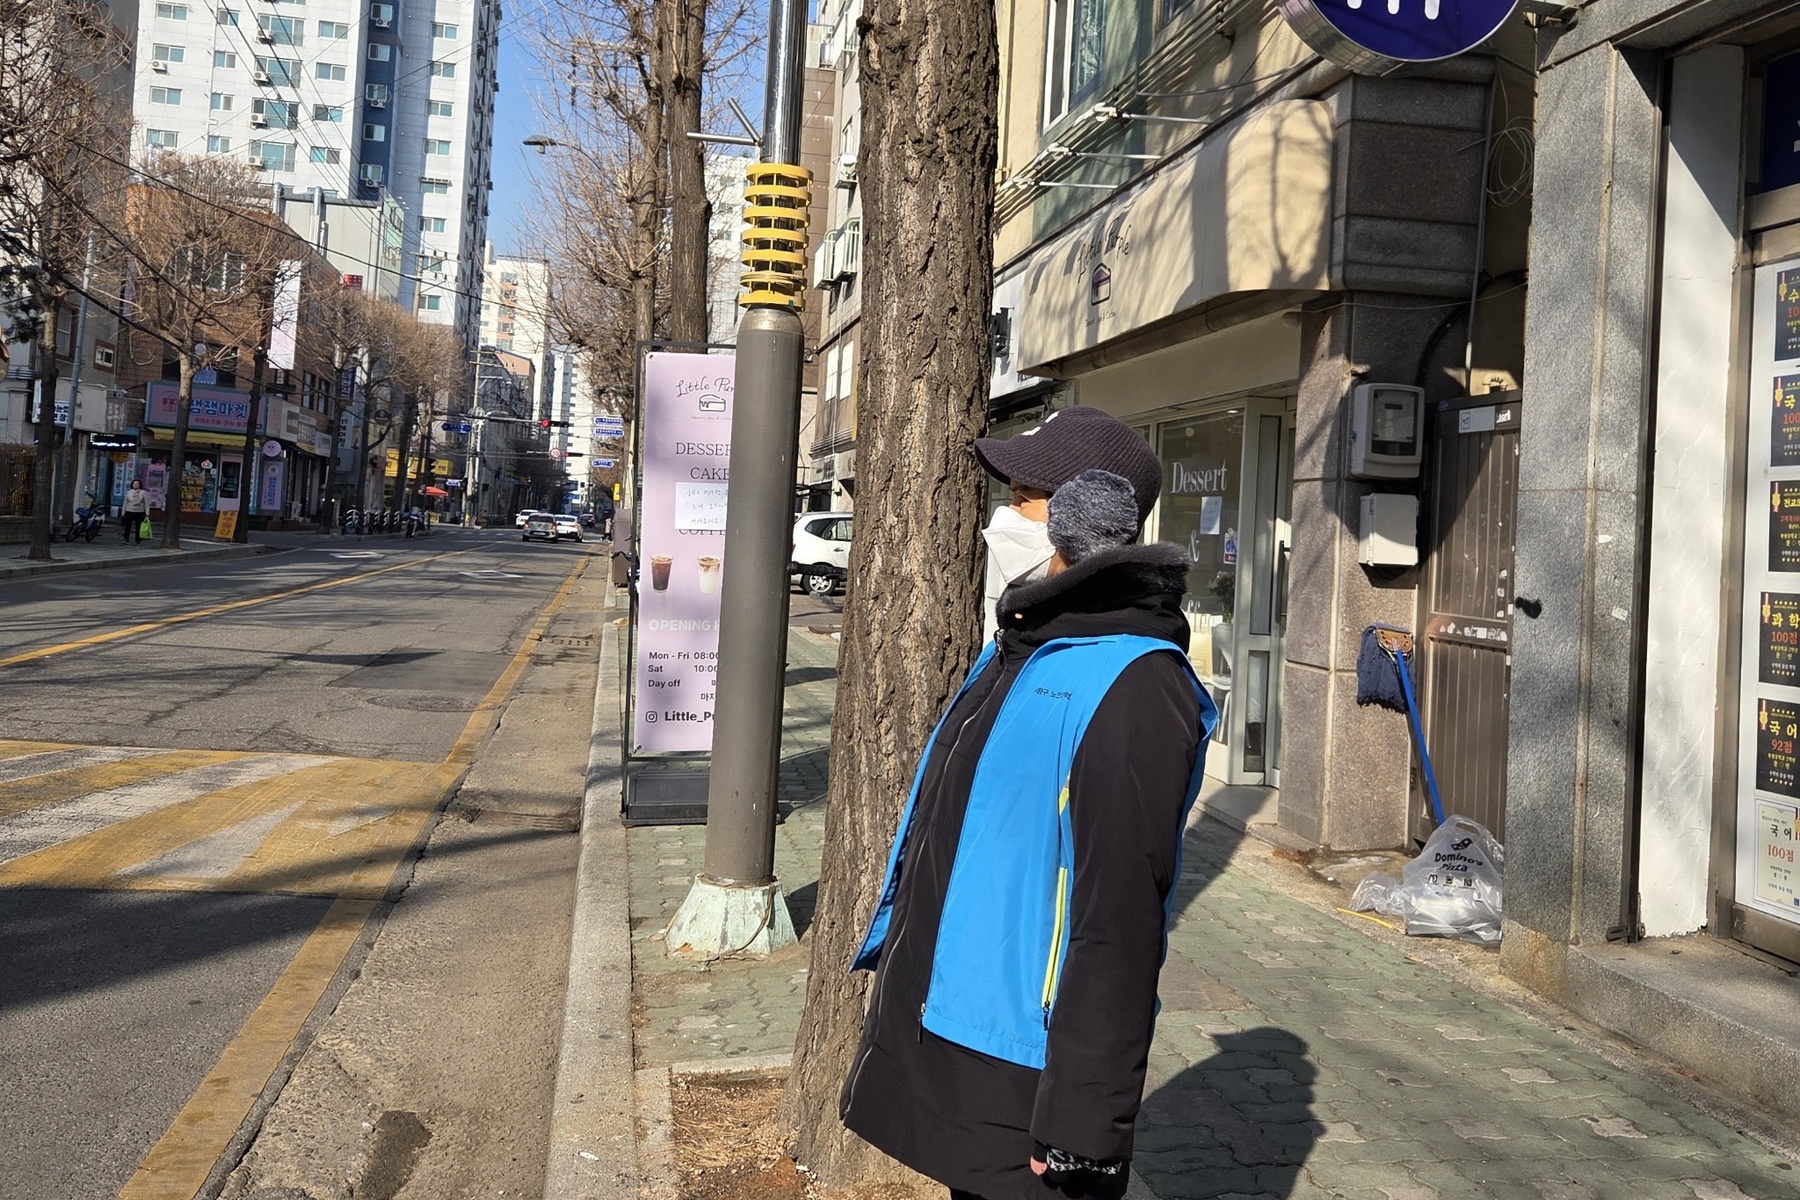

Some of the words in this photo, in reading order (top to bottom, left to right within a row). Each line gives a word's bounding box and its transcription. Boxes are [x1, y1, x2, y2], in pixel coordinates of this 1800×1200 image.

[1077, 224, 1105, 284] Little
[1104, 217, 1131, 260] Purple
[675, 376, 711, 398] Little
[1170, 459, 1228, 494] Dessert
[1188, 530, 1200, 562] &
[649, 619, 711, 632] OPENING
[1771, 631, 1798, 645] 100점
[649, 651, 669, 660] Mon
[677, 651, 690, 660] Fri
[648, 664, 663, 673] Sat
[648, 679, 666, 690] Day
[667, 679, 681, 688] off
[1769, 720, 1781, 736] 국
[1786, 723, 1798, 740] 어
[1771, 739, 1793, 754] 92점
[1769, 823, 1779, 837] 국
[1783, 827, 1792, 841] 어
[1435, 852, 1483, 866] Domino's
[1767, 844, 1794, 863] 100점
